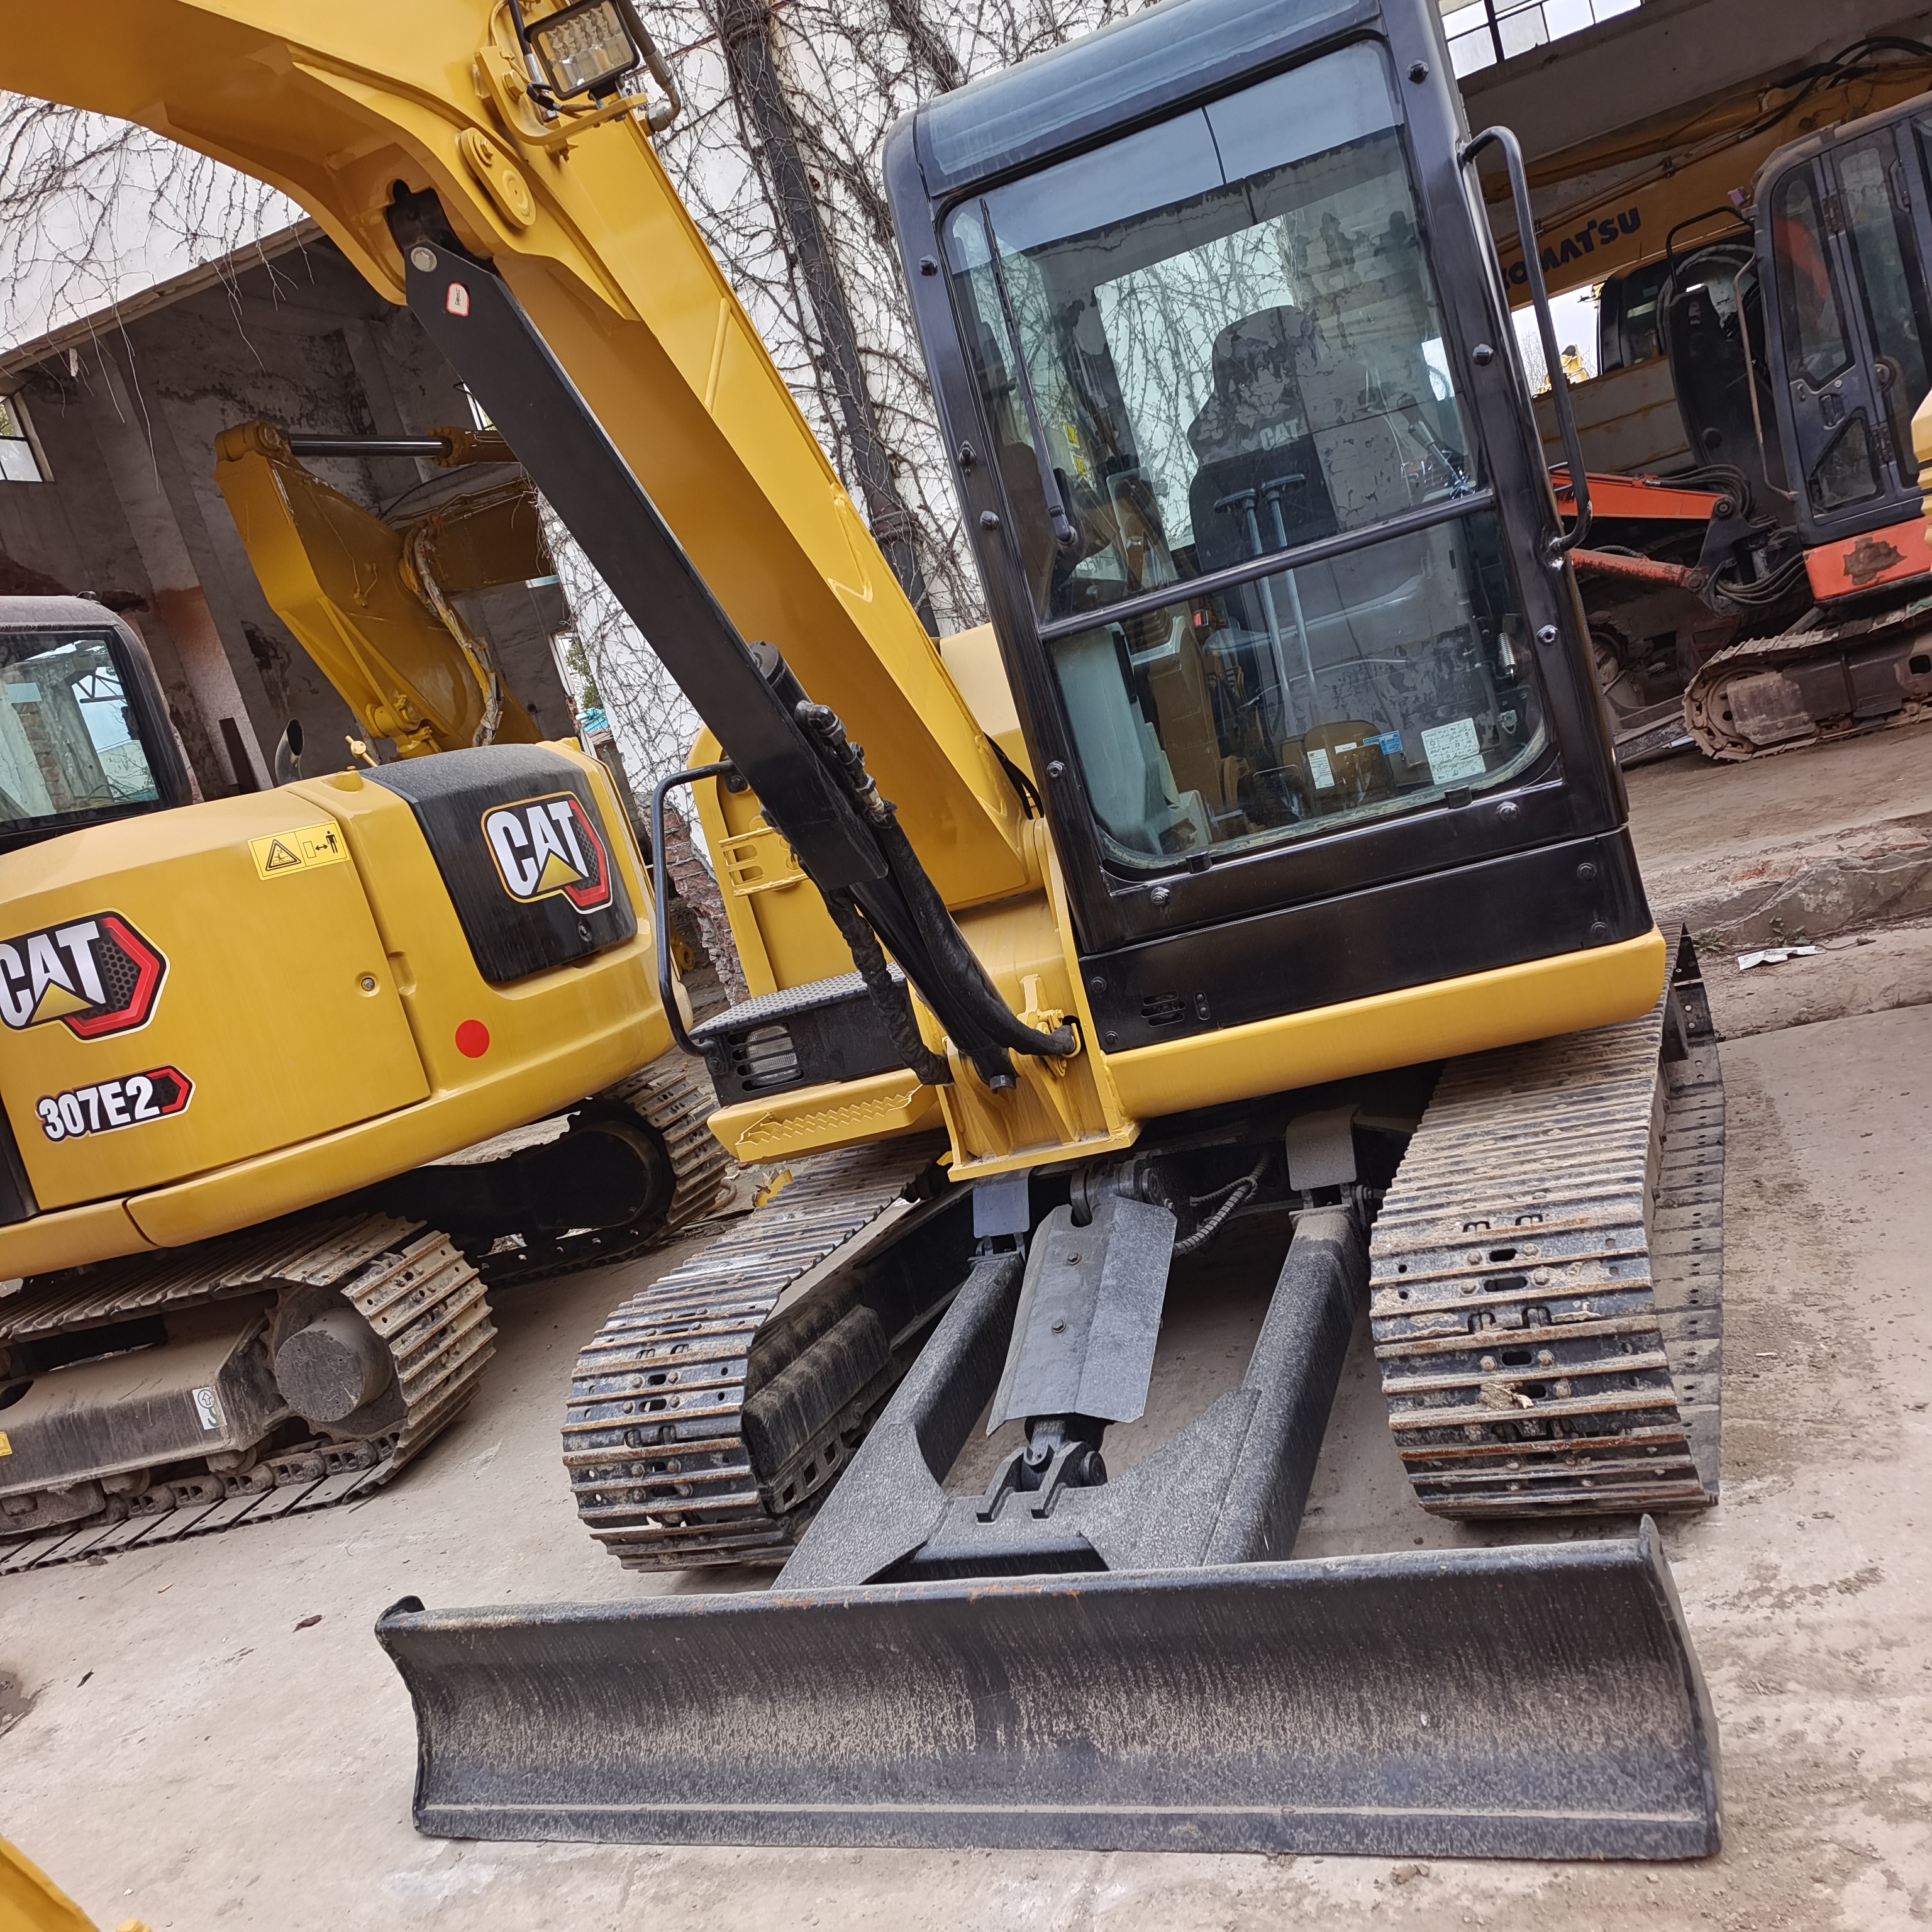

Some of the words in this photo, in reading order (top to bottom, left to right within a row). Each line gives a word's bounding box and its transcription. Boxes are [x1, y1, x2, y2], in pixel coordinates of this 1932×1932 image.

[1260, 418, 1299, 451] CAT
[487, 801, 589, 896] CAT
[0, 921, 106, 1026] CAT
[39, 1076, 160, 1139] 307E2
